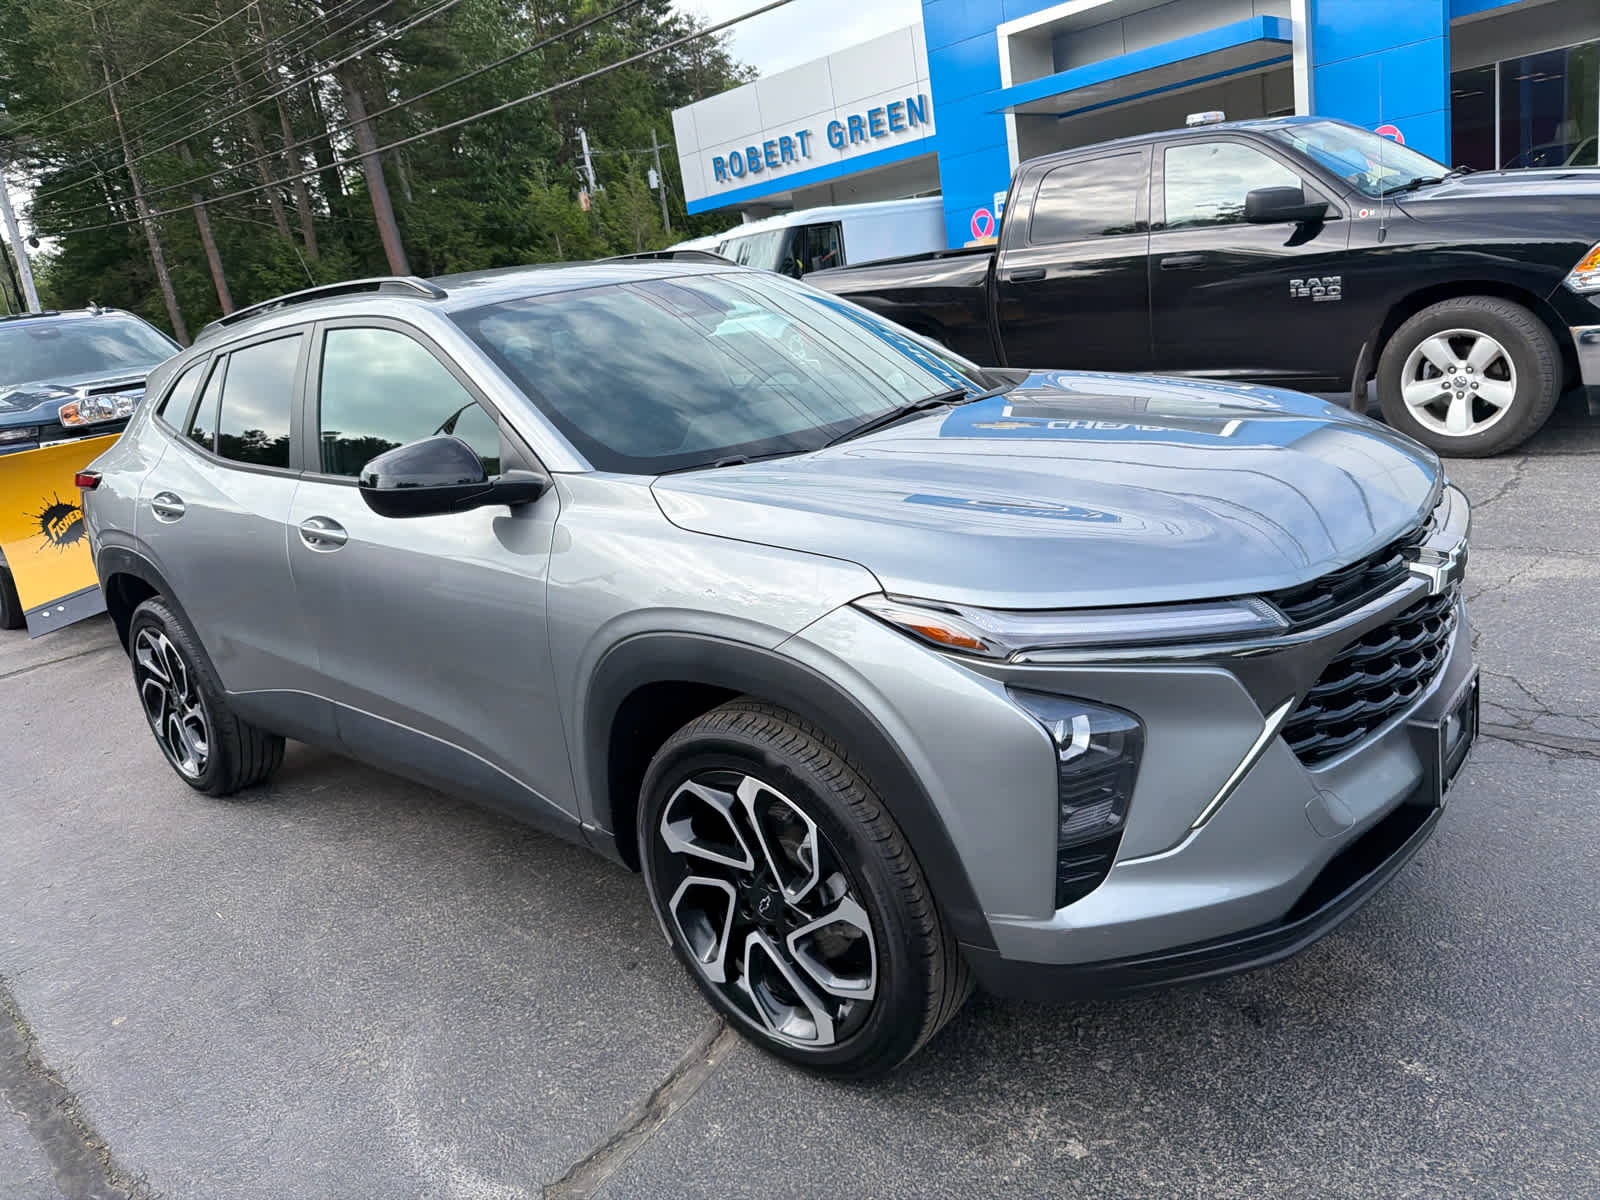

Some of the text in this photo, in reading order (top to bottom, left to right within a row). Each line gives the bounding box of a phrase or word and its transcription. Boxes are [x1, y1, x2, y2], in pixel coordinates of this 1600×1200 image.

[712, 94, 929, 182] ROBERT GREEN
[1289, 275, 1342, 289] RAM
